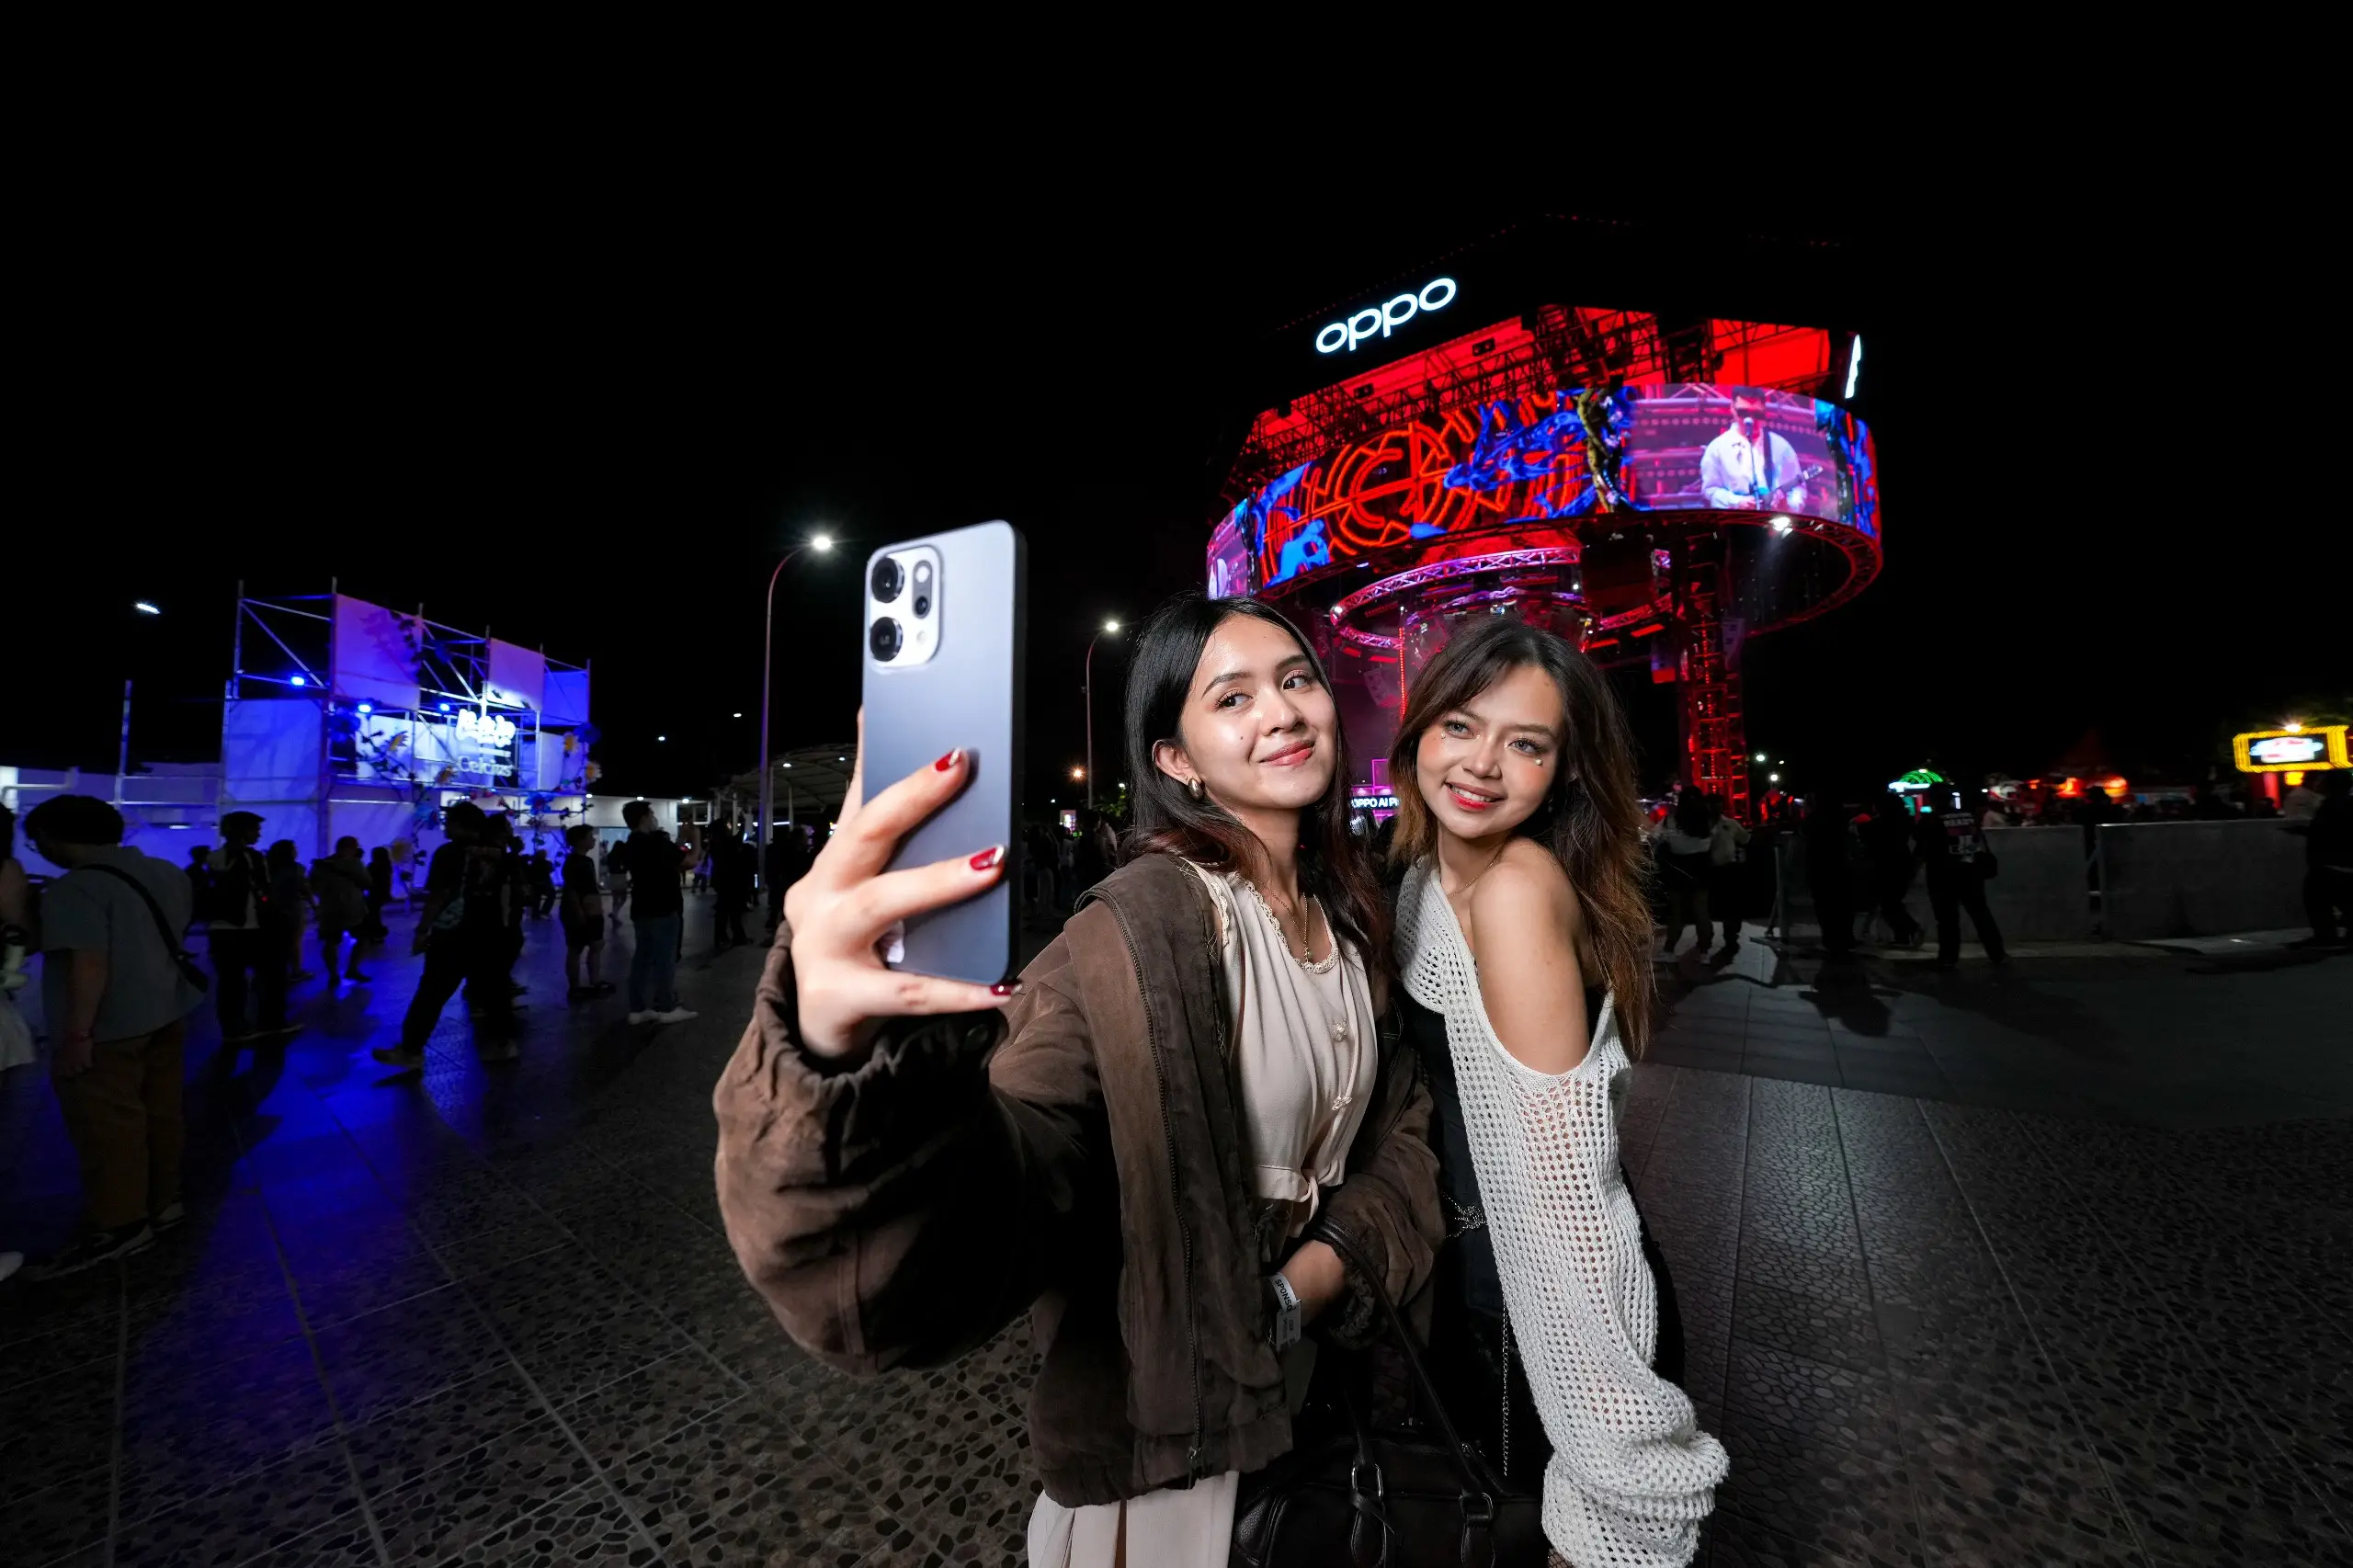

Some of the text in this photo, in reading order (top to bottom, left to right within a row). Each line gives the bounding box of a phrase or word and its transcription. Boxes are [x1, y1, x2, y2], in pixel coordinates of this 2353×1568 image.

[1315, 278, 1457, 354] oppo
[1351, 797, 1378, 808] OPPO
[1378, 797, 1388, 807] AI
